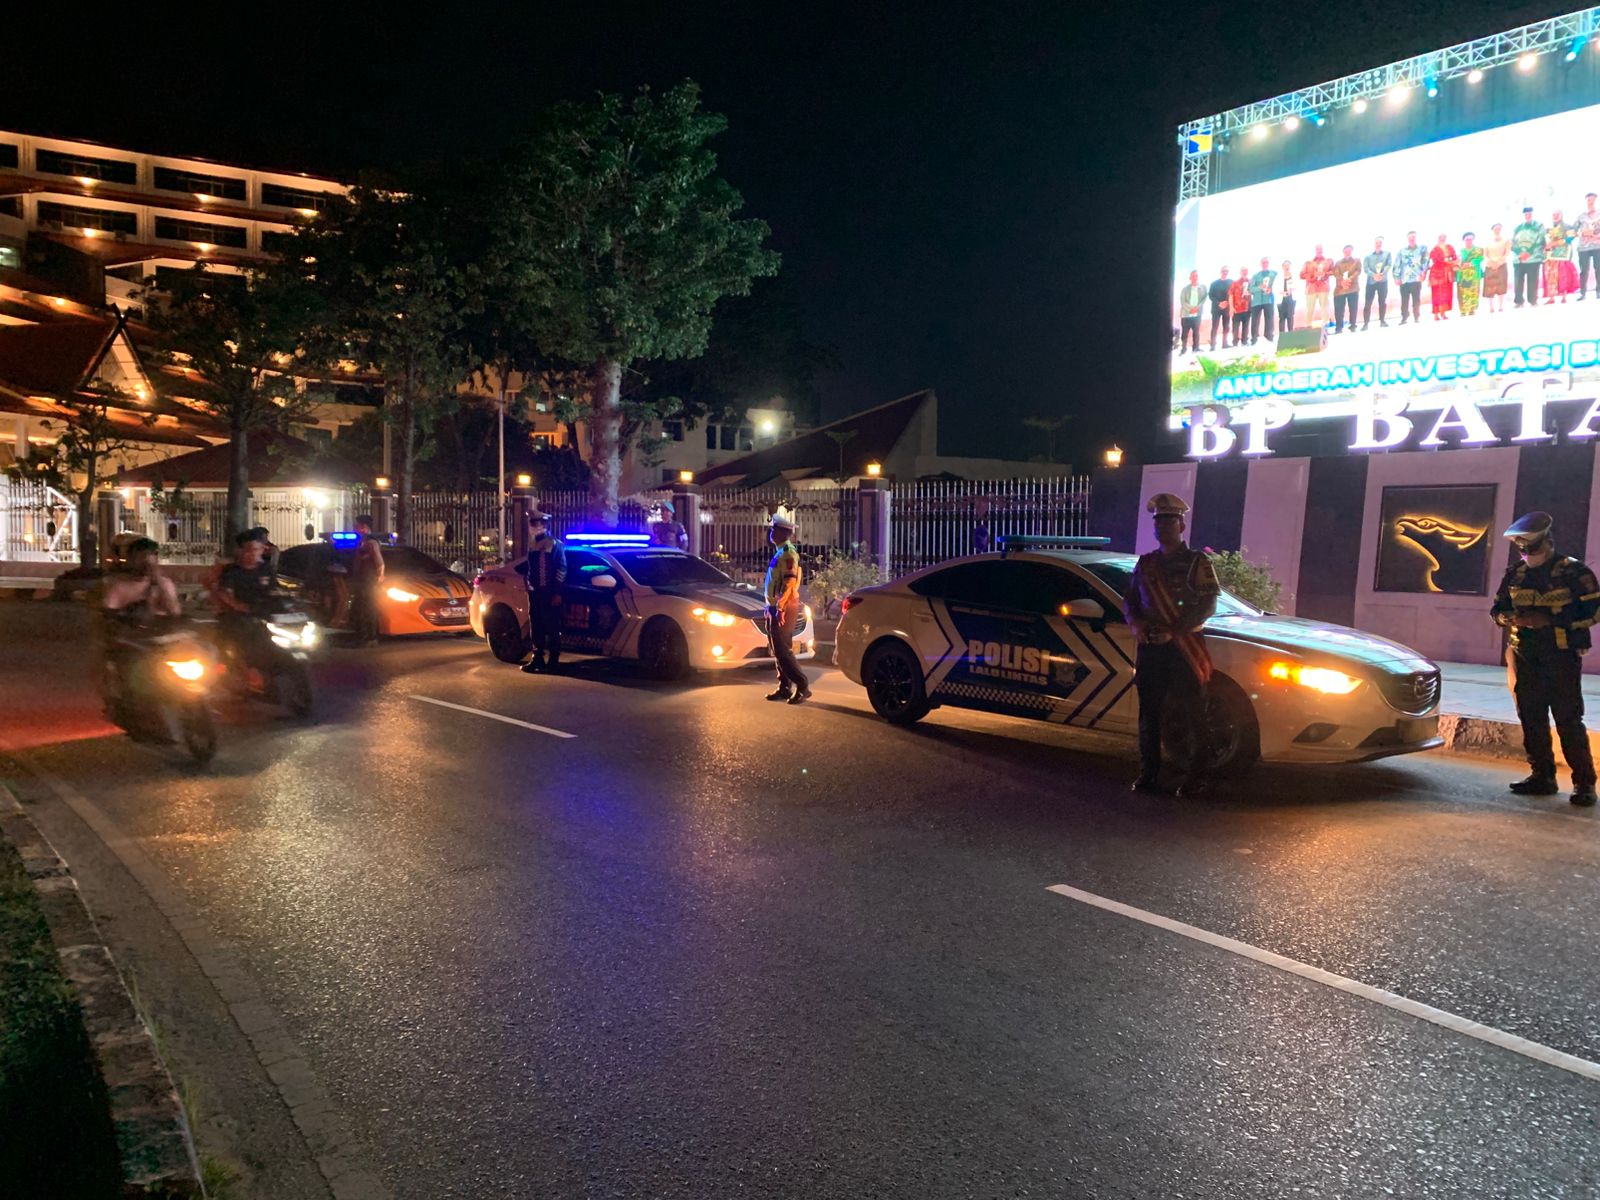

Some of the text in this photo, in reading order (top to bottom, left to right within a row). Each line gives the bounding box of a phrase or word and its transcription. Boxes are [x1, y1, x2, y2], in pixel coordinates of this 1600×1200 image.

[1213, 340, 1600, 399] ANUGERAH INVESTASI B
[1184, 399, 1295, 458] BP
[968, 639, 1050, 676] POLISI
[1001, 669, 1049, 686] LINTAS
